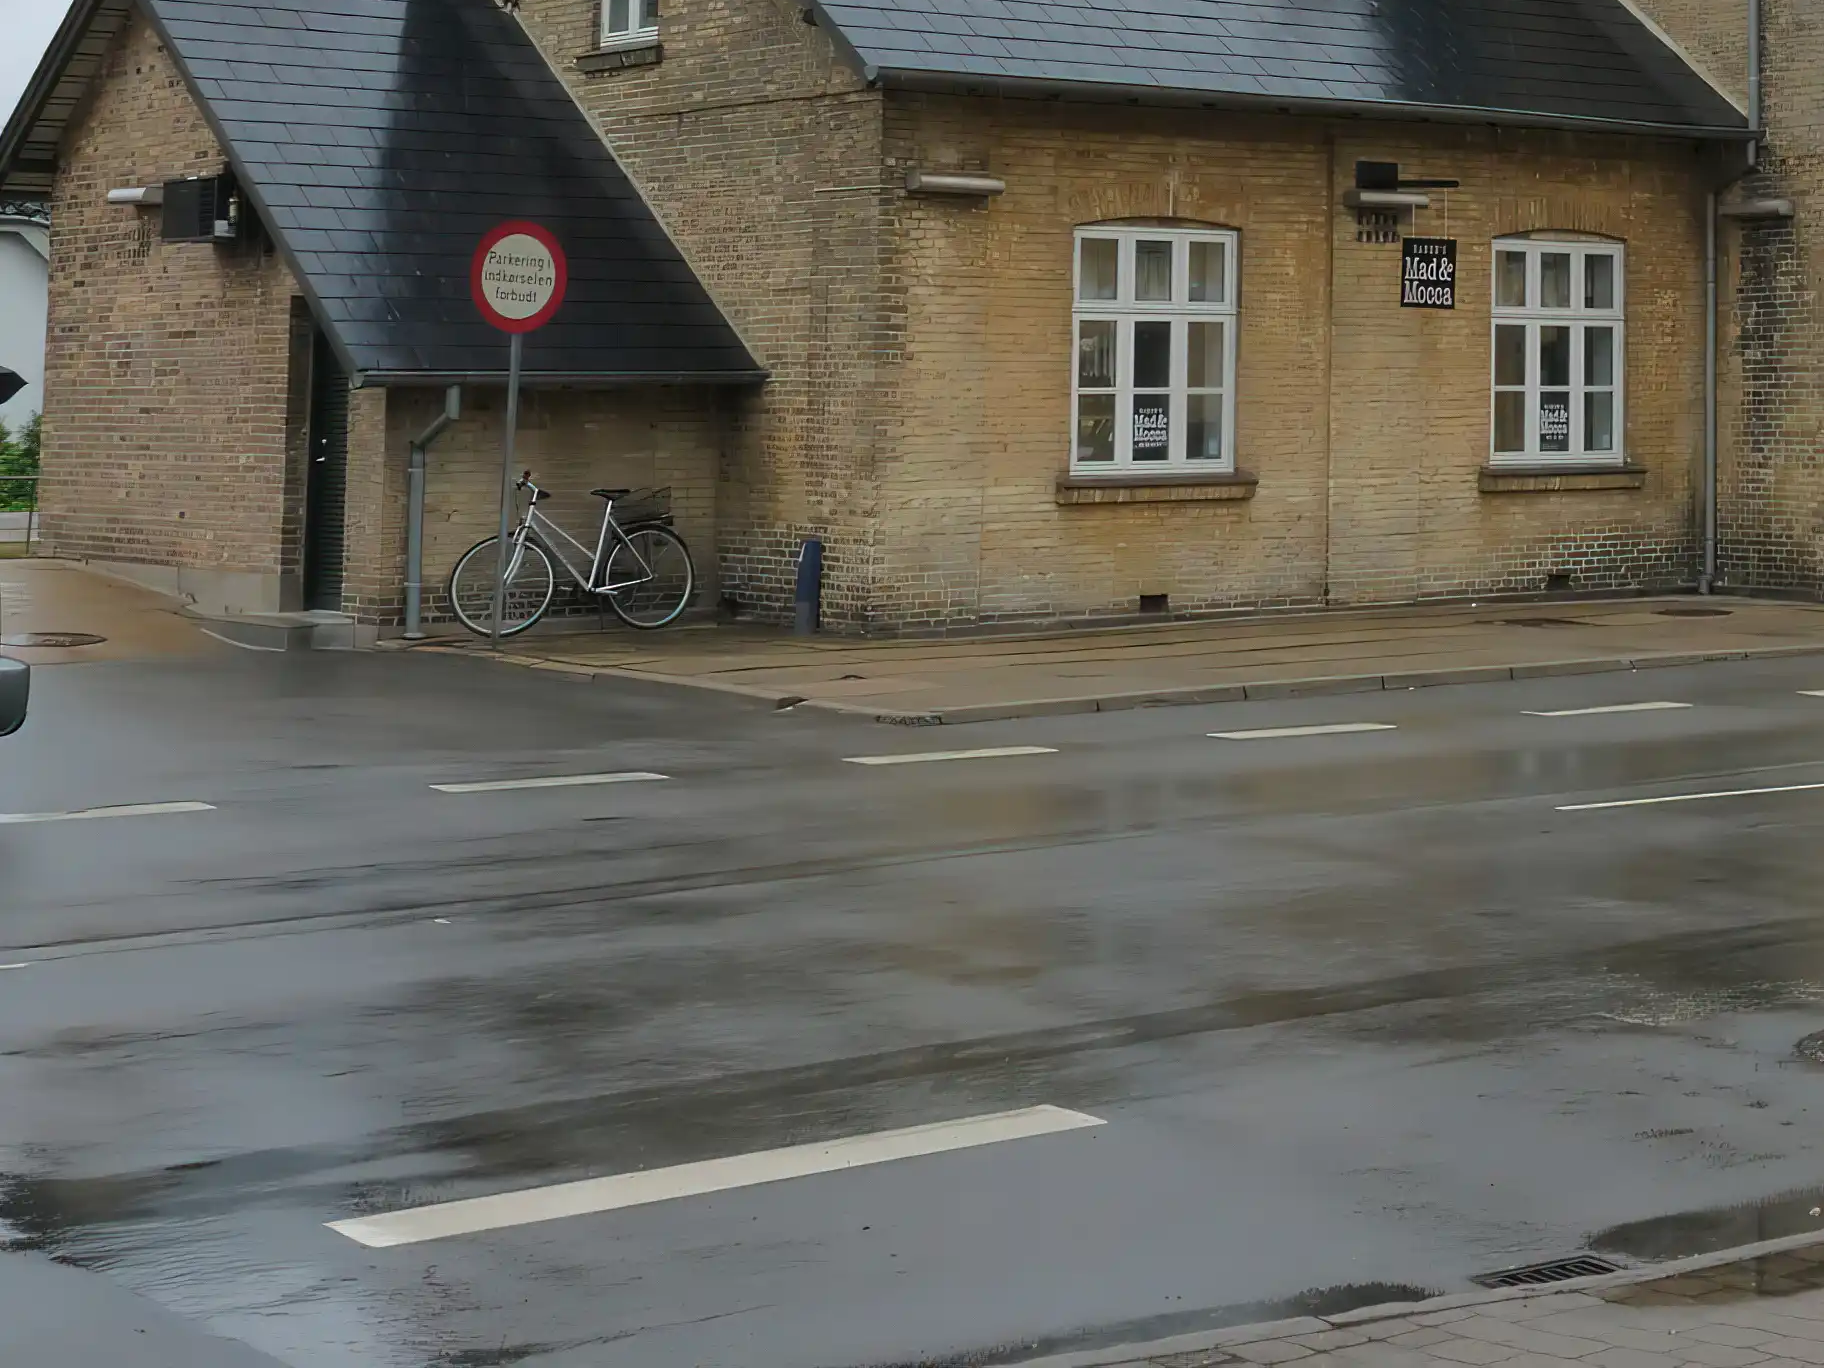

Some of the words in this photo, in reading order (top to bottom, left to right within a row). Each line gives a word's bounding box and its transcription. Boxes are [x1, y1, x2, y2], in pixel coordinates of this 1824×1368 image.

[488, 250, 545, 272] Parkering
[495, 286, 537, 303] forbudt
[1403, 280, 1453, 305] Mocca
